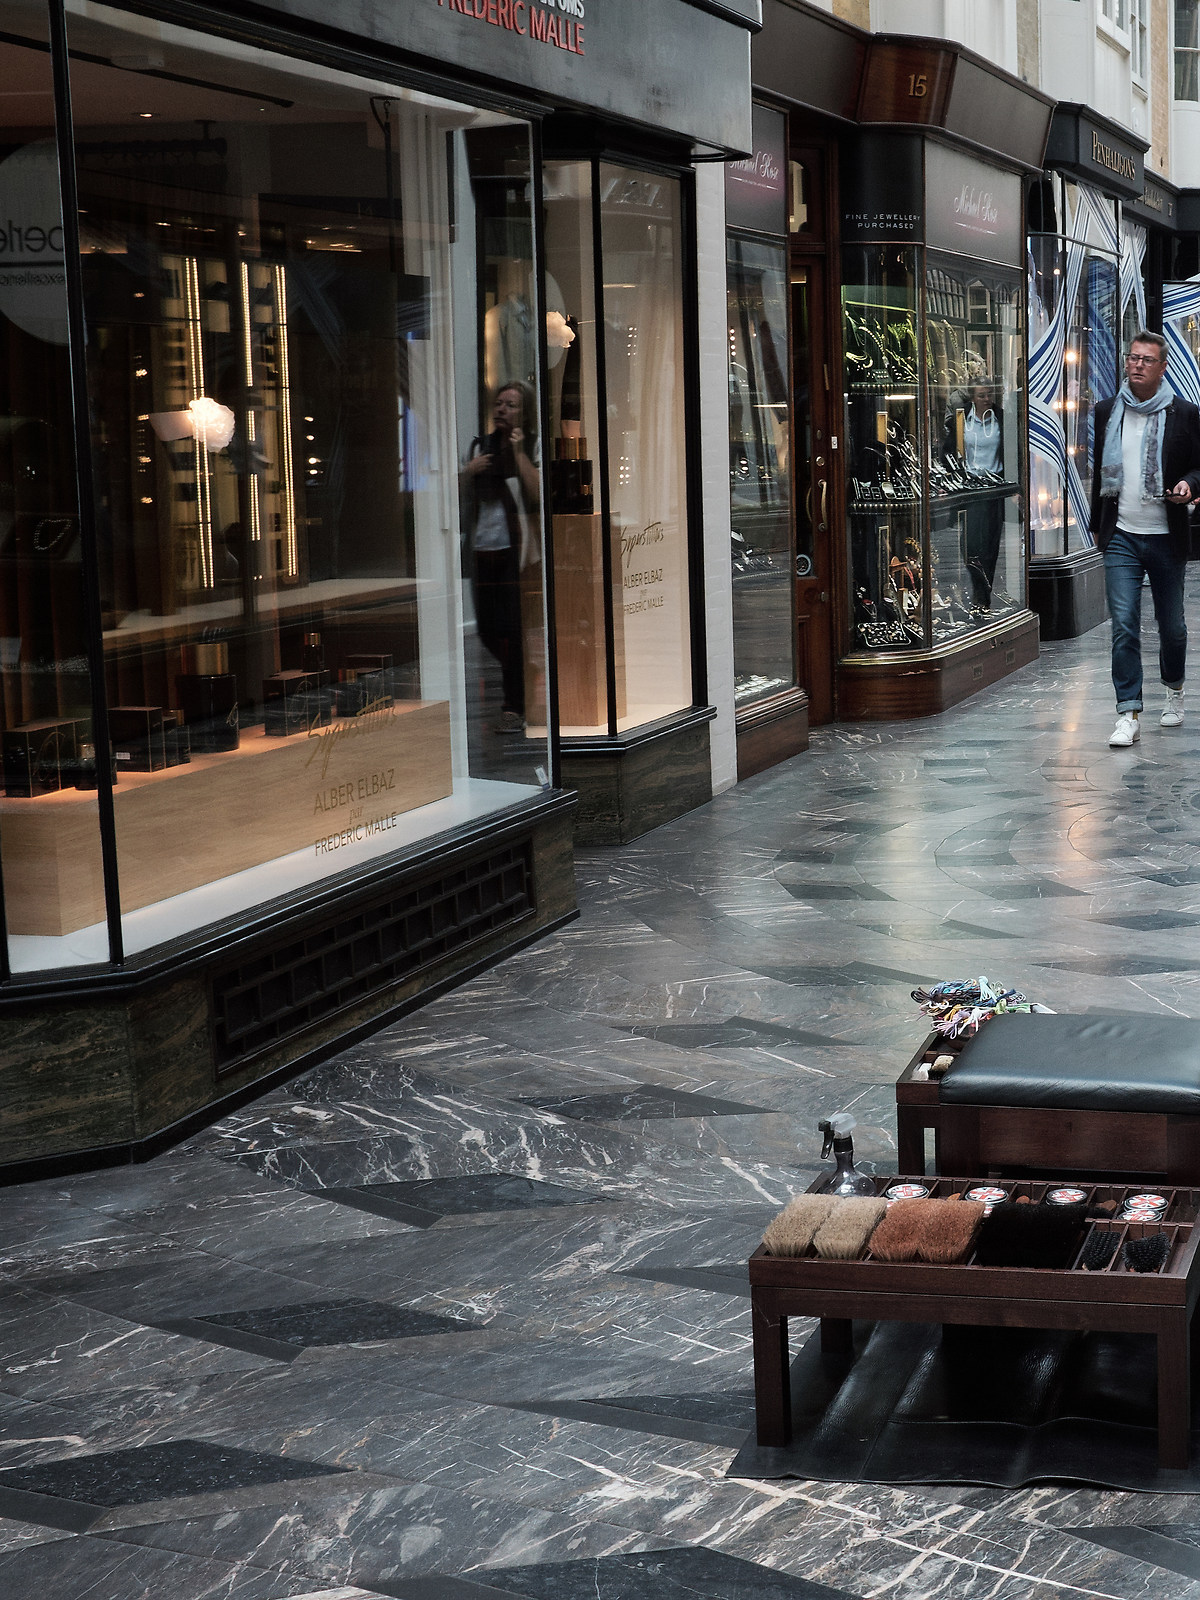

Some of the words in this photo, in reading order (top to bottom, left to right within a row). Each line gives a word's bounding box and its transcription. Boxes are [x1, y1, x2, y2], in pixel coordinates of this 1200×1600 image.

[438, 0, 527, 35] DERIC
[530, 6, 585, 56] MALLE
[908, 74, 928, 97] 15
[1092, 131, 1136, 180] PENHALIGON'S
[857, 222, 914, 230] PURCHASED
[873, 213, 921, 221] JEWELLERY
[623, 573, 643, 589] ALBER
[644, 568, 663, 585] ELBAZ
[313, 782, 355, 815] ALBER
[358, 768, 396, 800] ELBAZ
[314, 824, 363, 857] FREDERIC
[365, 811, 397, 838] MALLE
